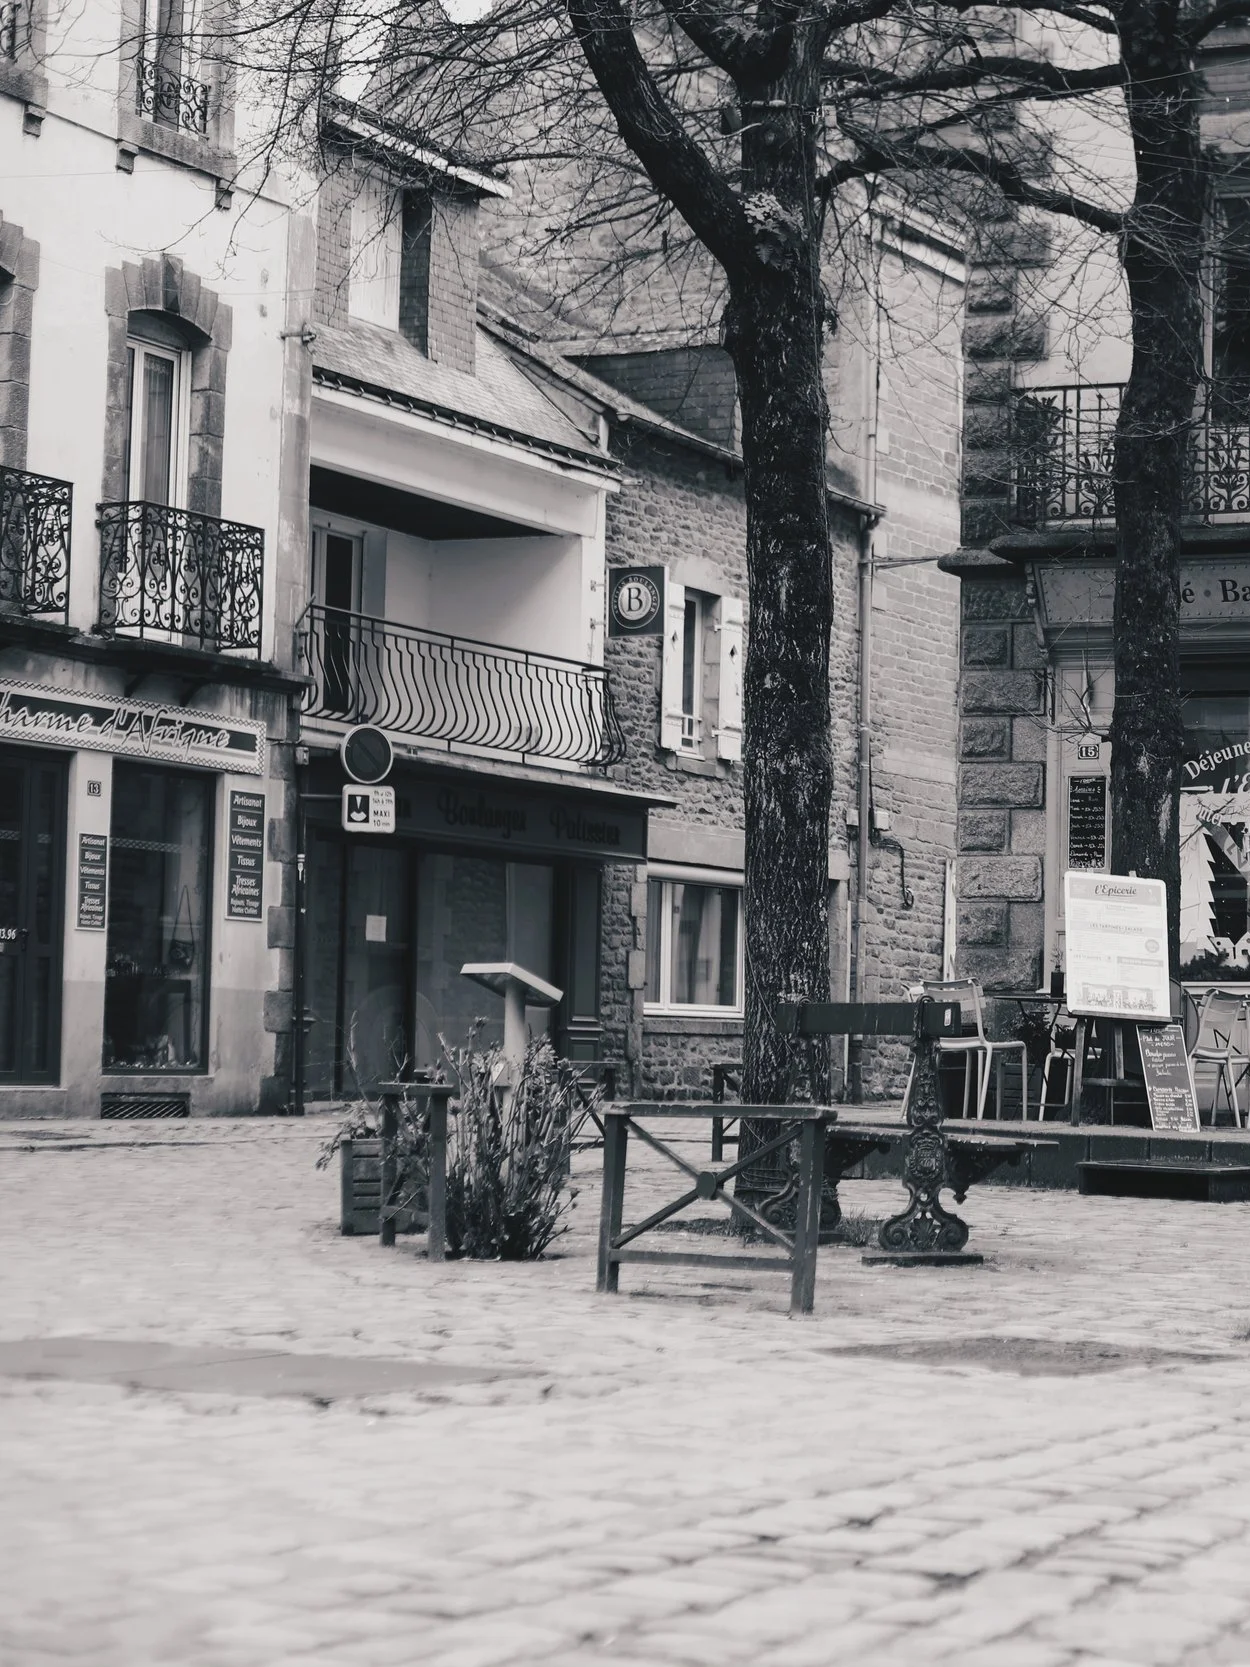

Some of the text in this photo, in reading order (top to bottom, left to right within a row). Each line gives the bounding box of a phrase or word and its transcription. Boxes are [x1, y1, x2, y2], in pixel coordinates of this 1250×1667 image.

[627, 587, 643, 612] B
[100, 708, 230, 760] d'Afrique
[1082, 746, 1095, 757] 15
[233, 795, 262, 807] Artisanat
[373, 810, 390, 818] MAXI
[237, 815, 257, 828] Bijoux
[231, 834, 262, 848] Vêtements
[237, 855, 256, 866] Tissus
